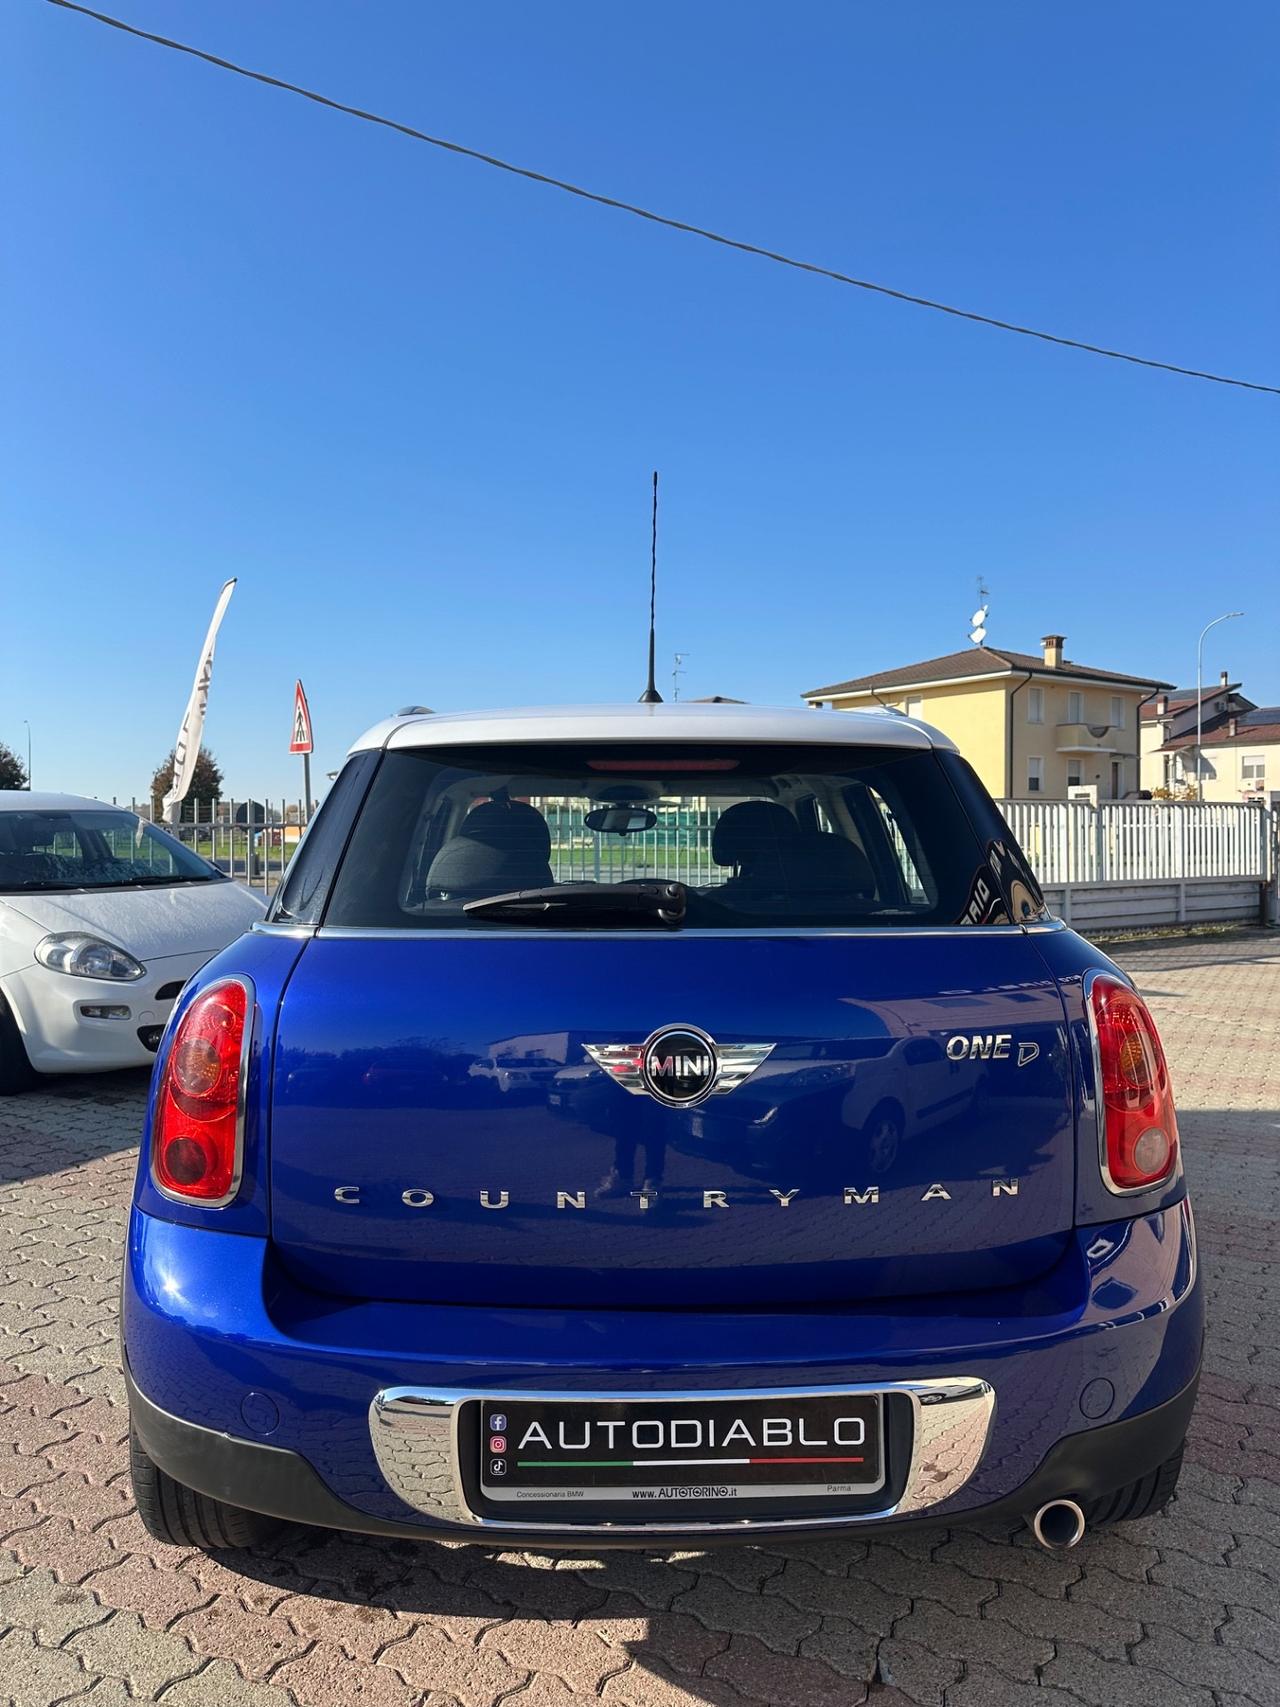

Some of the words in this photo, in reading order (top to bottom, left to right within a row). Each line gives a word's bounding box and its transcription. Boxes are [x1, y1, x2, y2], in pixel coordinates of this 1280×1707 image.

[946, 1034, 1012, 1060] ONE
[1018, 1042, 1040, 1067] D
[650, 1055, 710, 1078] MINI
[333, 1177, 1019, 1209] COUNTRYMAN
[518, 1416, 866, 1450] AUTODIABLO
[516, 1490, 566, 1498] Concessionaria
[567, 1490, 584, 1498] BMW
[632, 1486, 737, 1499] www.AUTOTORINO.it
[827, 1484, 852, 1493] Parma
